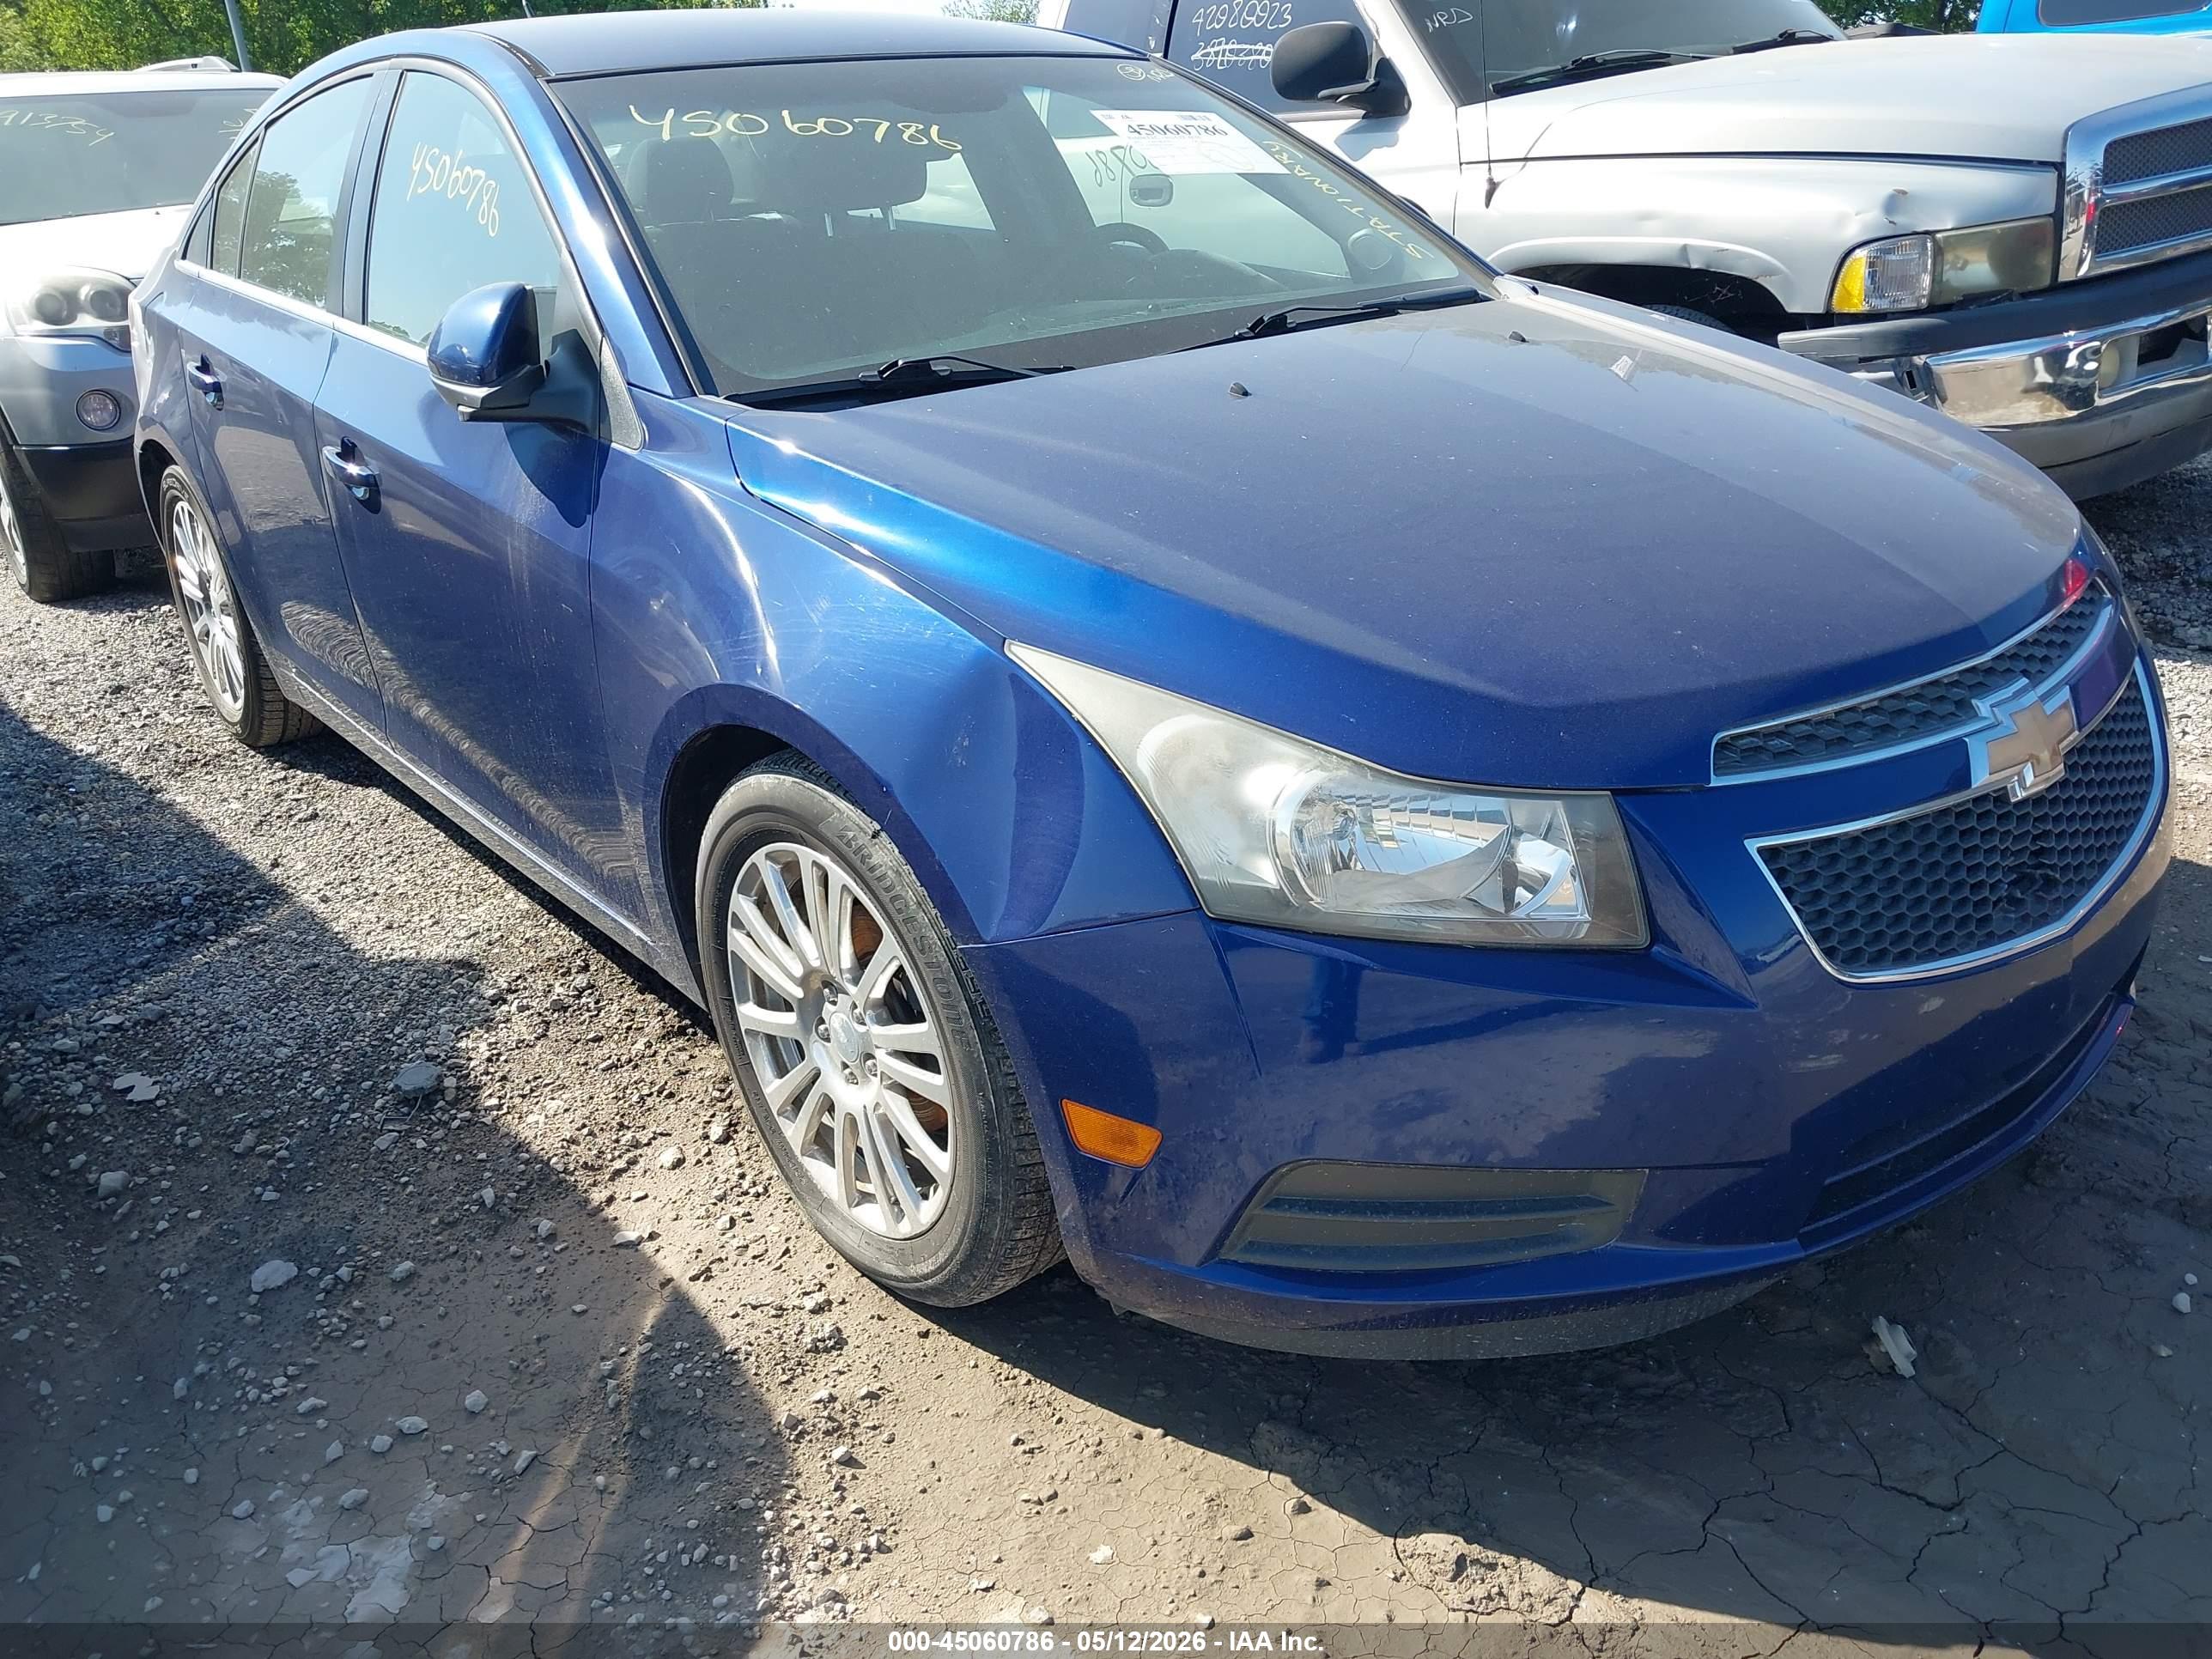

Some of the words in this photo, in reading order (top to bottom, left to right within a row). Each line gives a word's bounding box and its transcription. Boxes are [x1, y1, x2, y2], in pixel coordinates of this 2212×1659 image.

[629, 104, 963, 152] 45060786
[1127, 123, 1230, 137] 45060786
[406, 141, 501, 238] 45060786
[1261, 140, 1436, 260] STATIONARY
[836, 823, 974, 1053] BRIDGESTONE
